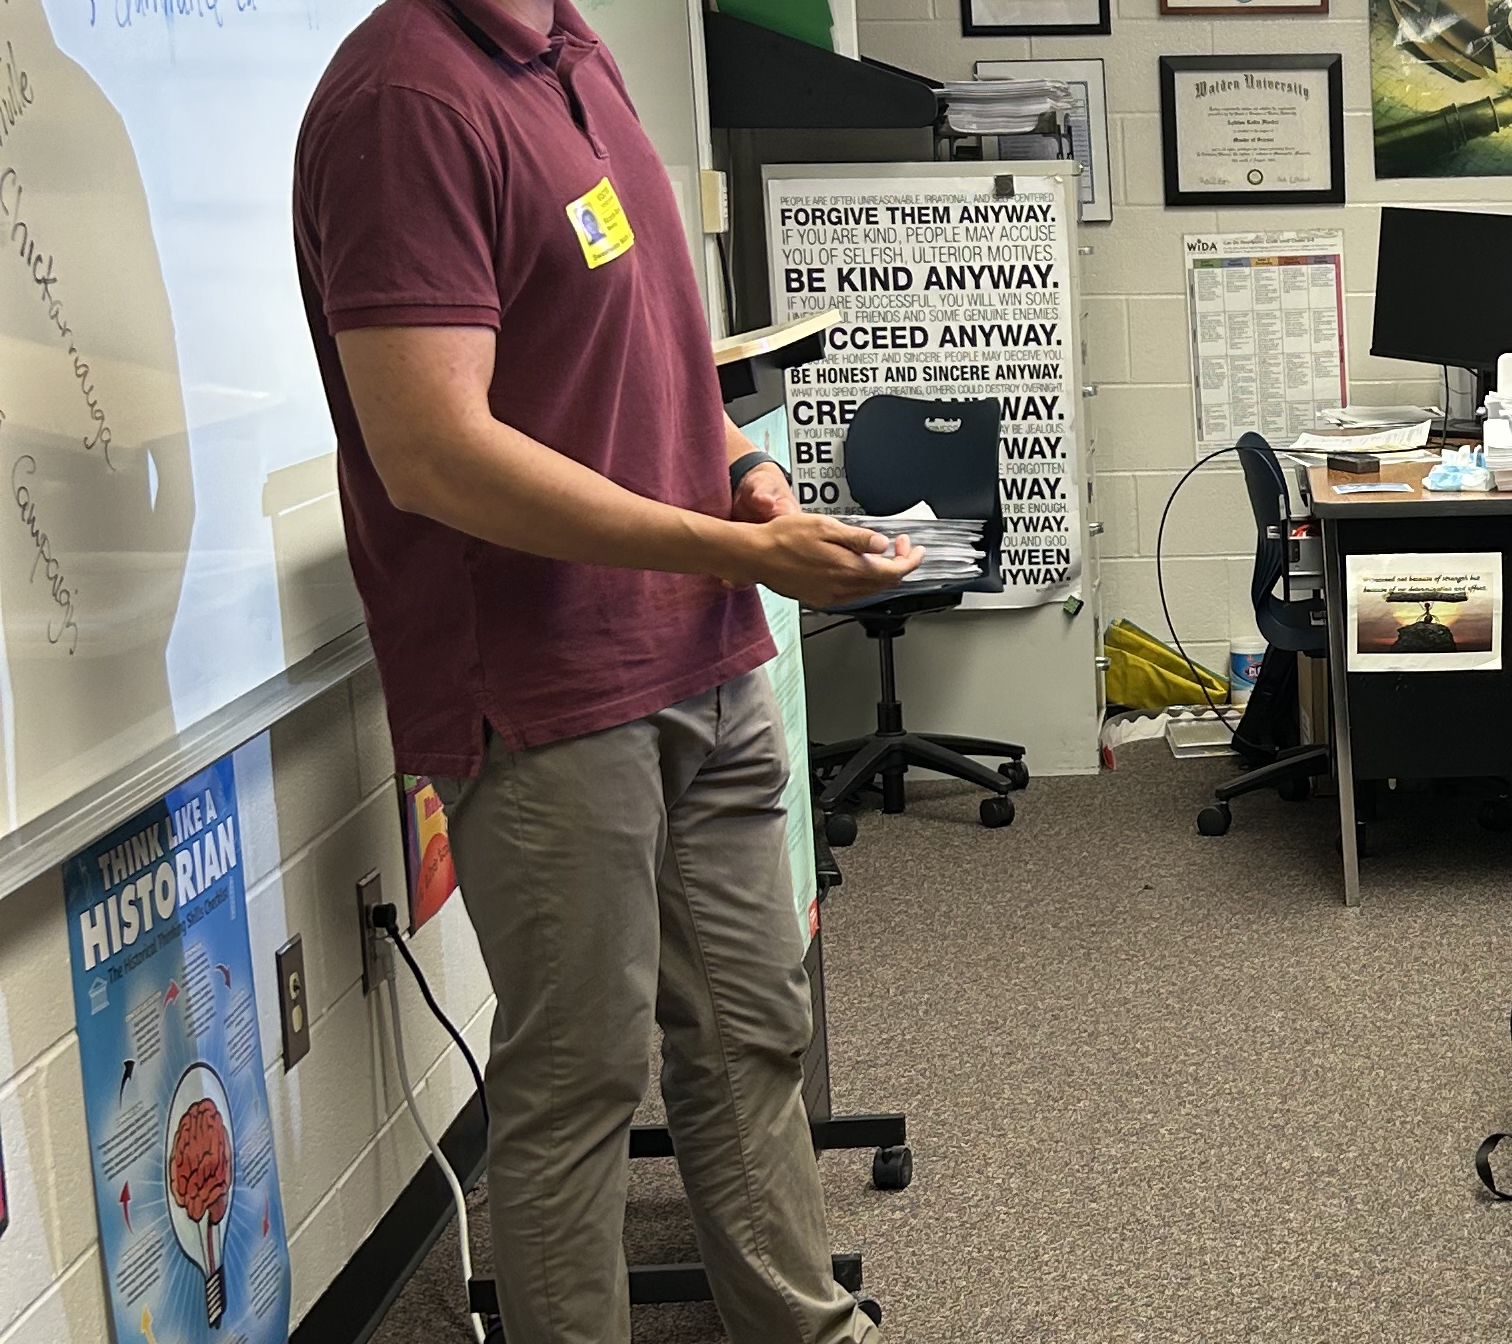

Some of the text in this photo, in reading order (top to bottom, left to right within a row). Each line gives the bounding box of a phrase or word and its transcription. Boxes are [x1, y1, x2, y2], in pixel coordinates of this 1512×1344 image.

[1195, 73, 1310, 102] Walden University
[780, 204, 1056, 226] FORGIVE THEM ANYWAY.
[782, 225, 1056, 245] IF YOU ARE KIND, PEOPLE MAY ACCUSE
[782, 244, 1056, 265] YOU OF SELFISH, ULTERIOR MOTIVES.
[785, 264, 1059, 292] BE KIND ANYWAY.
[787, 292, 1060, 310] IF YOU ARE SUCCESSFUL, YOU WILL WIN SOME
[856, 310, 900, 323] FRIENDS
[903, 309, 925, 322] AND
[929, 309, 960, 322] SOME
[964, 308, 1010, 321] GENUINE
[824, 324, 1062, 350] CCEED ANYWAY.
[790, 364, 1062, 384] BE HONEST AND SINCERE ANYWAY.
[793, 396, 1064, 425] CRE WAY.
[795, 442, 833, 463] BE
[797, 467, 816, 479] THE
[798, 482, 839, 504] DO
[97, 789, 218, 891] THINK LIKE A
[80, 816, 237, 971] HISTORIAN
[108, 965, 123, 984] The
